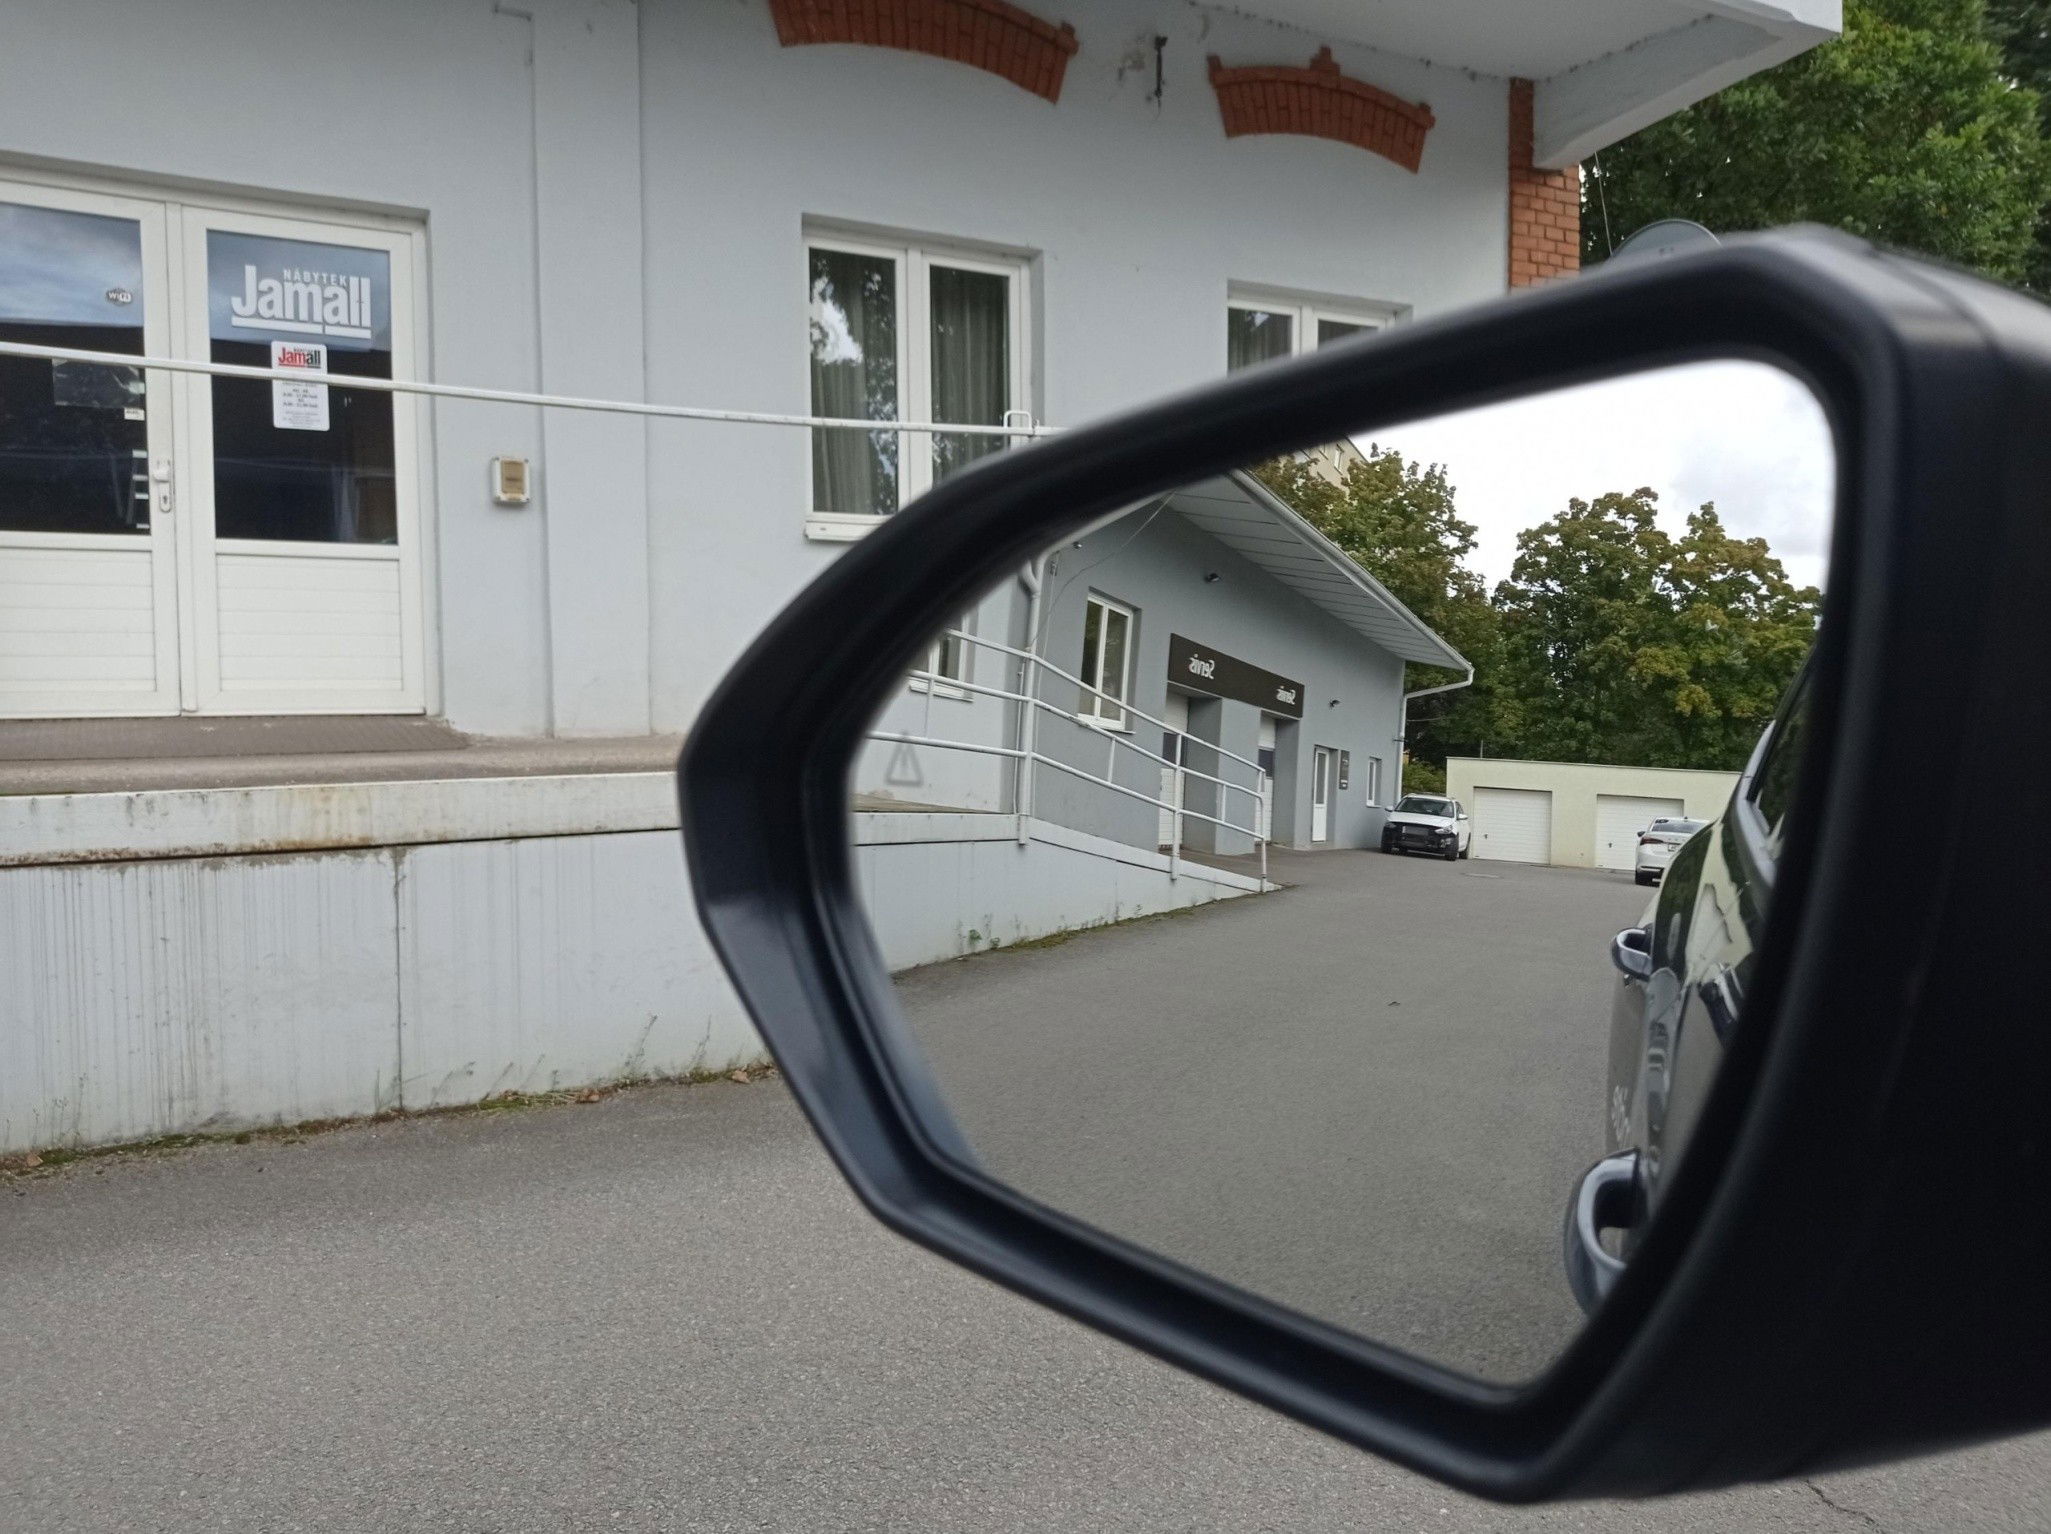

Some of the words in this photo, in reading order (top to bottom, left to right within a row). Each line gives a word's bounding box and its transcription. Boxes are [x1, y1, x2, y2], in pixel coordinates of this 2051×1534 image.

[283, 268, 348, 286] NÁBYTEK
[231, 265, 371, 327] Jamall
[278, 347, 321, 365] Jamall
